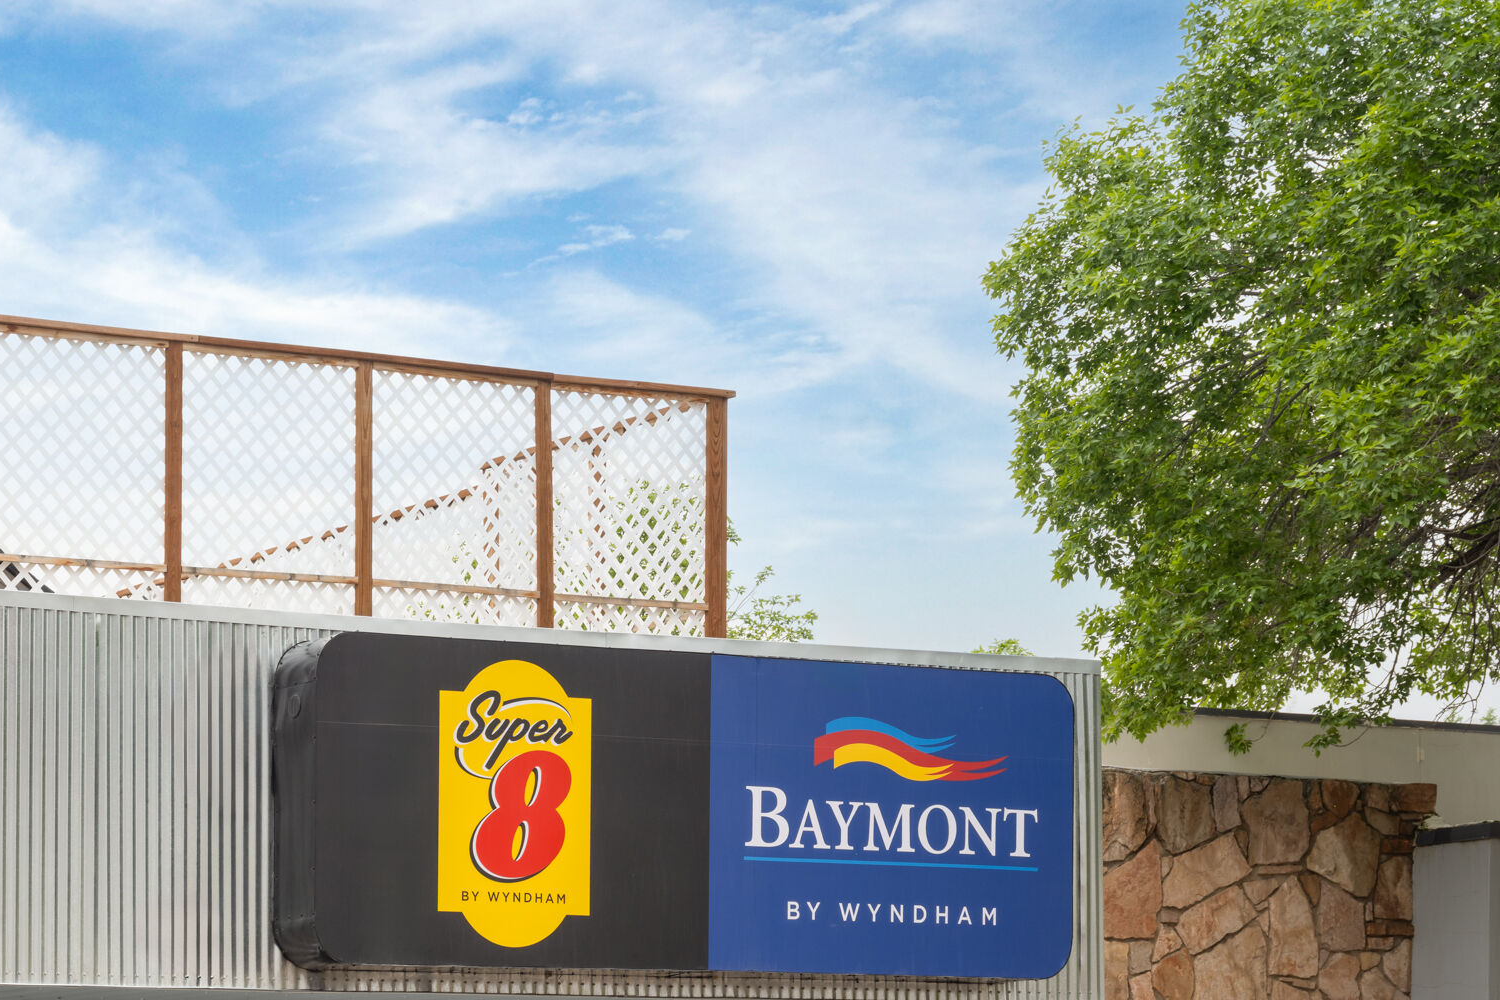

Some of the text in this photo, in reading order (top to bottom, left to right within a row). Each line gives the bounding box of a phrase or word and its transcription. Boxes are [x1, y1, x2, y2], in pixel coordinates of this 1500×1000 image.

[454, 690, 574, 771] Super
[469, 750, 572, 883] 8
[744, 785, 1039, 858] BAYMONT
[461, 891, 566, 904] BY WYNDHAM
[787, 901, 997, 926] BY WYNDHAM
